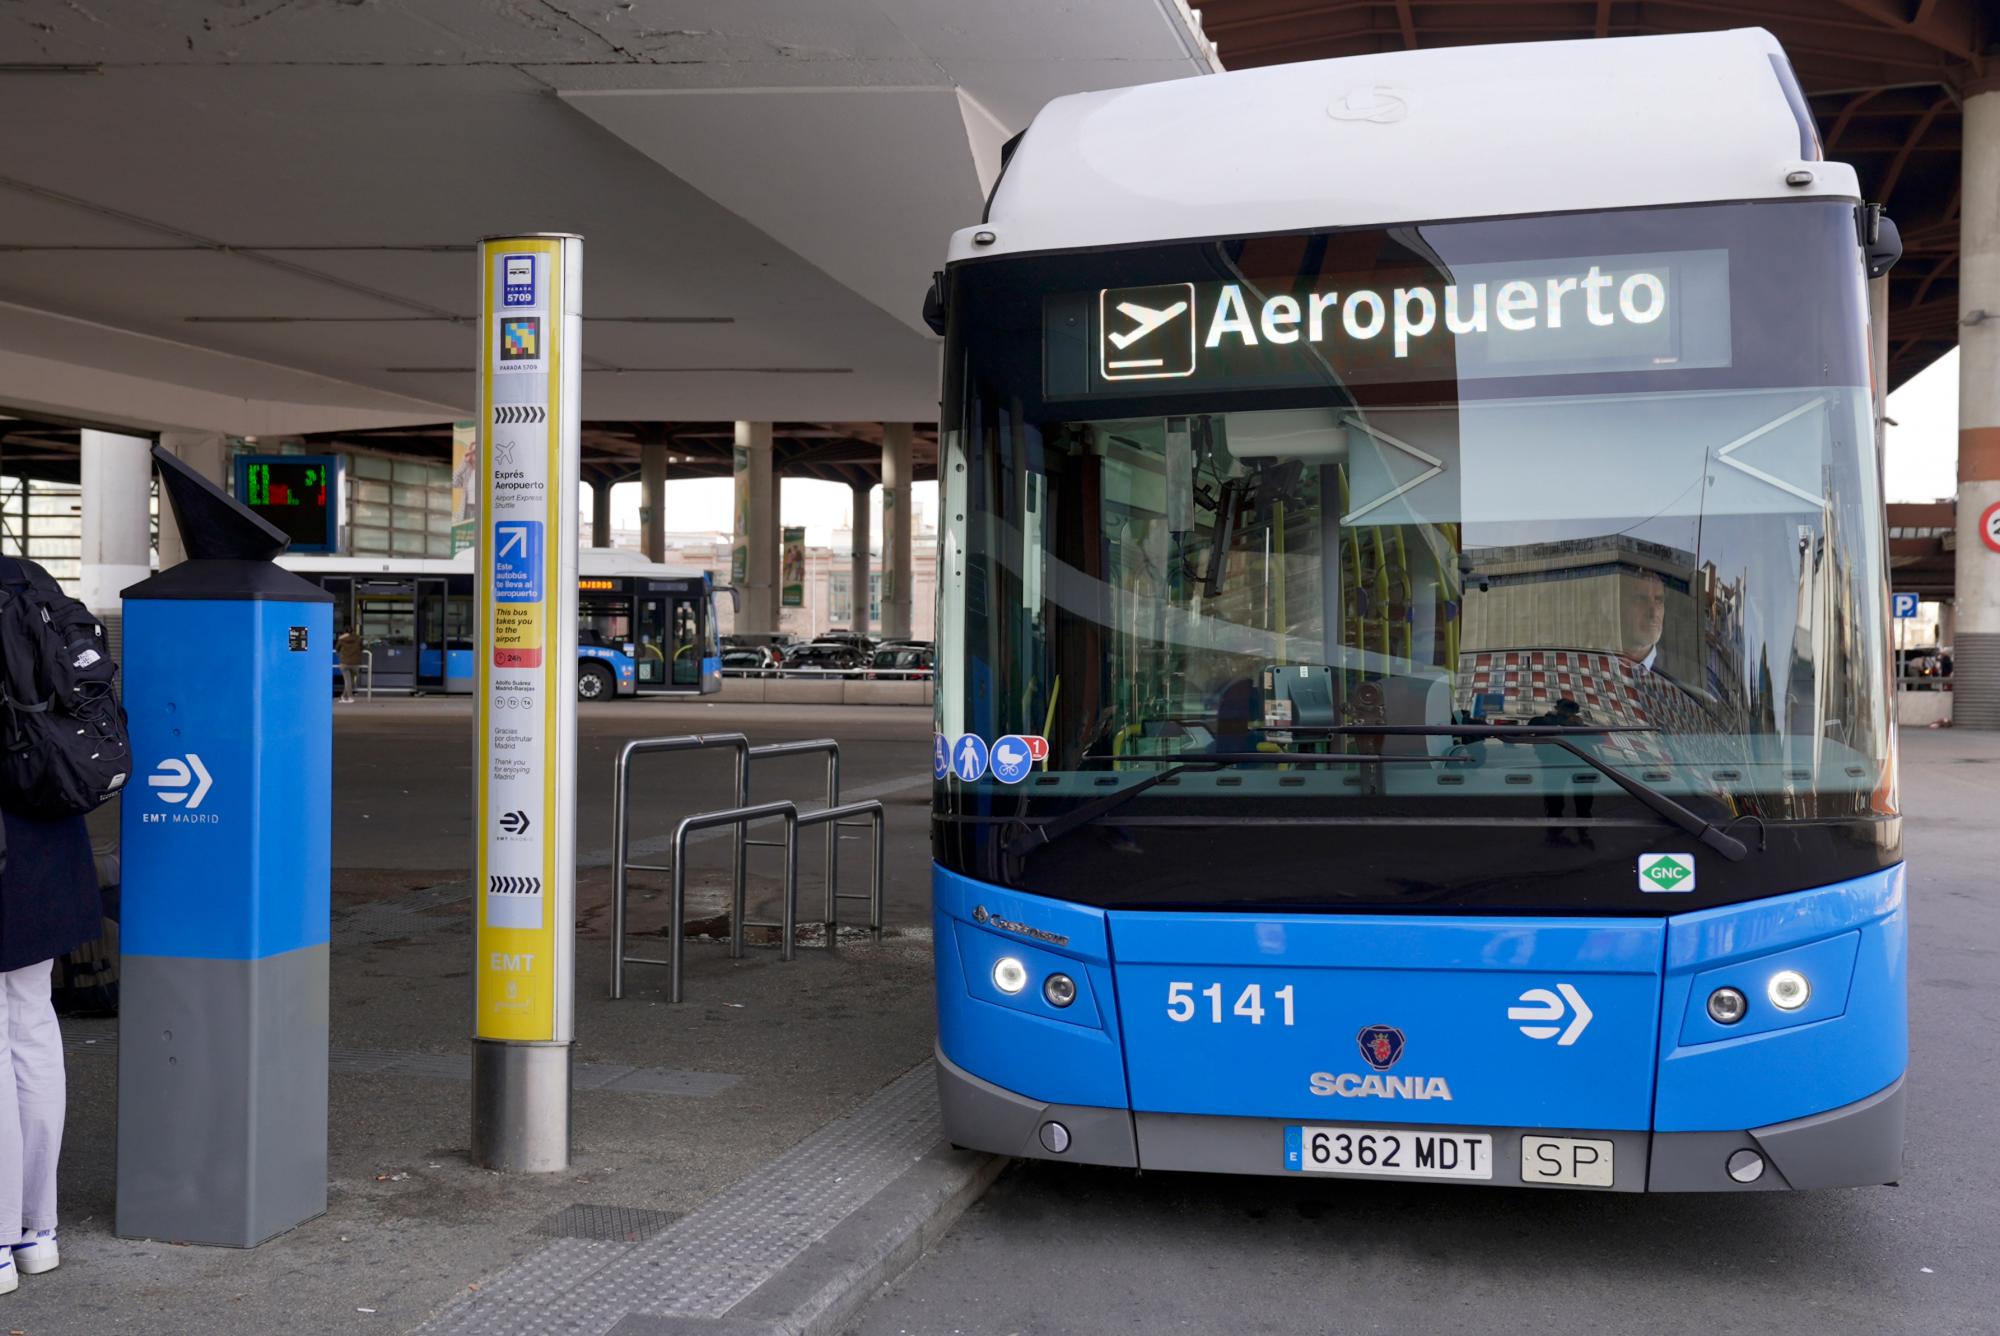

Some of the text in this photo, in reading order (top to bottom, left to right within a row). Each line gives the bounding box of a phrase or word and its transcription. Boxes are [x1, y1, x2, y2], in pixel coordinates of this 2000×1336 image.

[507, 293, 532, 302] 5709
[1204, 265, 1666, 358] Aeropuerto
[495, 469, 524, 480] Exprés
[495, 481, 544, 491] Aeropuerto
[516, 494, 543, 502] Express
[496, 563, 512, 571] Este
[496, 571, 528, 579] autobús
[495, 590, 538, 598] aeropuerto
[1896, 596, 1913, 616] P
[497, 608, 528, 616] This bus
[496, 617, 515, 625] takes
[505, 626, 517, 634] the
[507, 654, 521, 662] 24h
[494, 727, 518, 735] Gracias
[1033, 740, 1040, 753] 1
[503, 767, 531, 775] enjoying
[143, 813, 219, 824] EMT MADRID
[1651, 866, 1683, 879] GNC
[490, 953, 535, 972] EMT
[1166, 982, 1296, 1026] 5141
[1309, 1071, 1453, 1101] SCANIA
[1289, 1132, 1483, 1171] E 6362 MDT
[1536, 1143, 1600, 1178] SP
